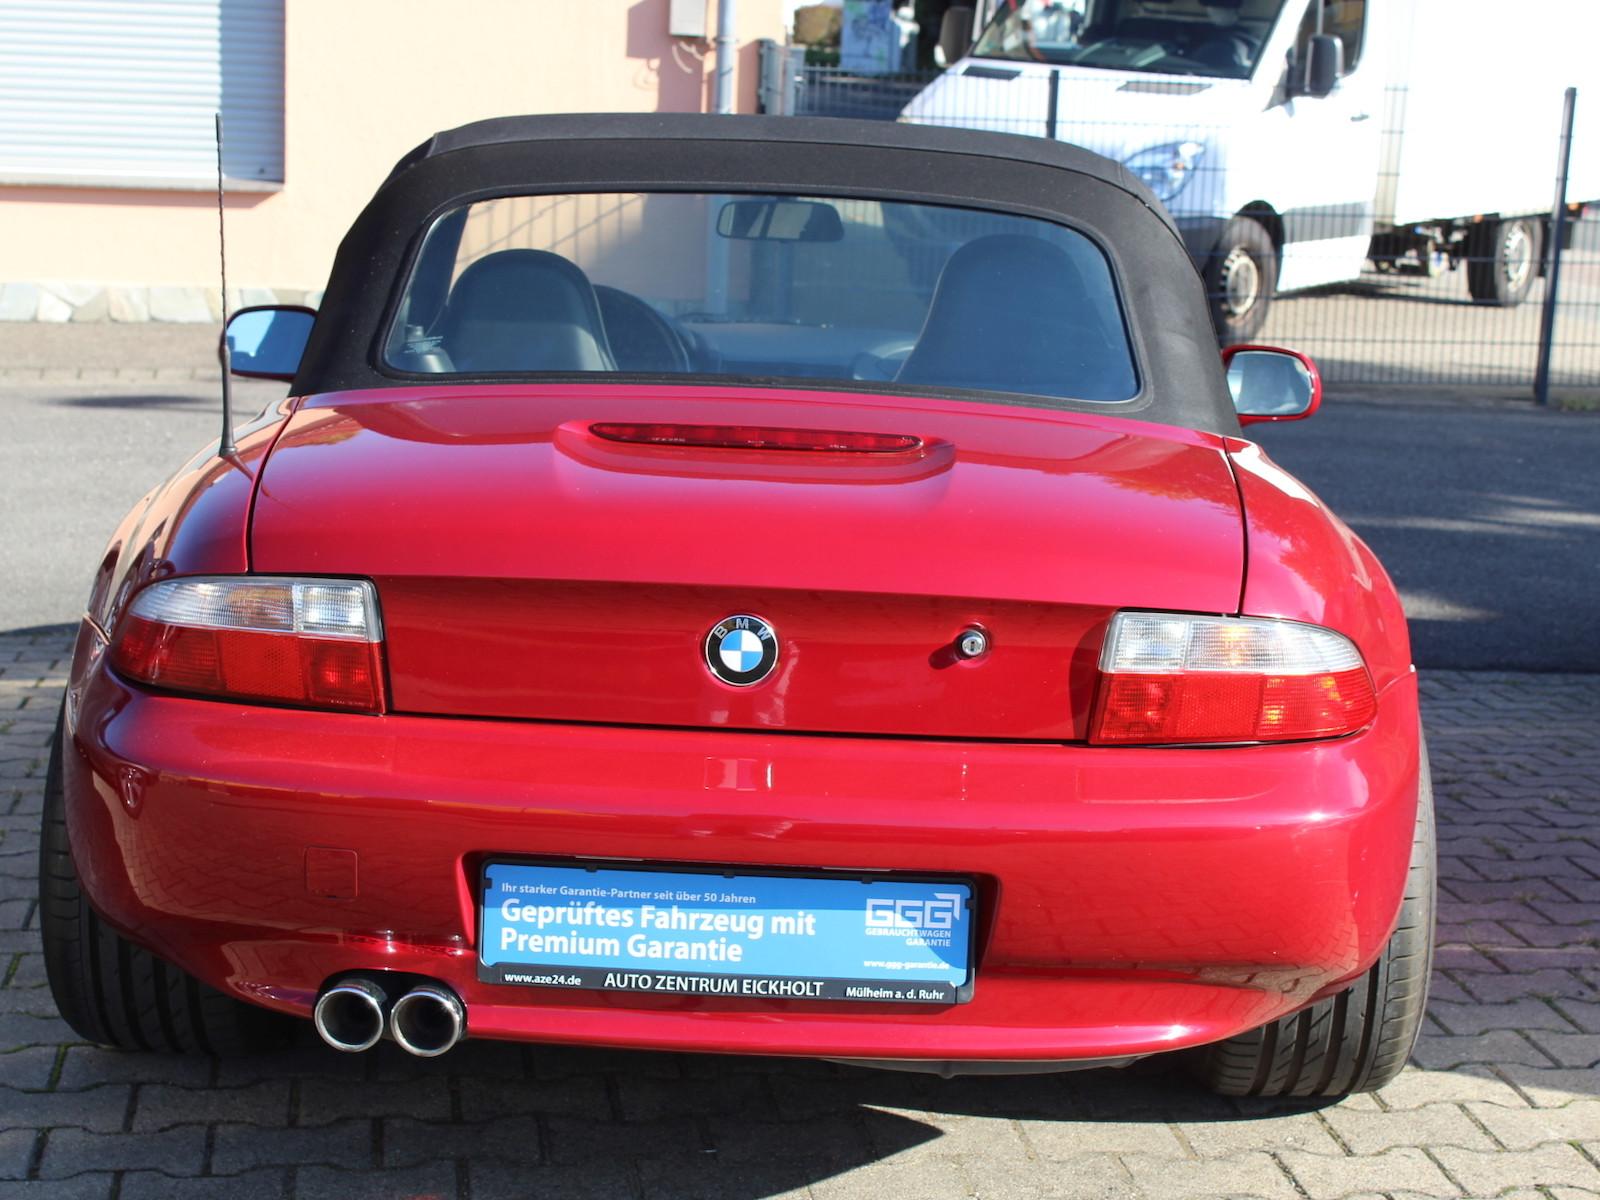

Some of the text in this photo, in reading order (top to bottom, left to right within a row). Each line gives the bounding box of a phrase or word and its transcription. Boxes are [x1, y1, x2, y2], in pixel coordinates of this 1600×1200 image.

[714, 618, 771, 641] BMW
[502, 883, 756, 904] Ihr starker Garantie-Partner seit über 50 Jahren
[501, 898, 817, 940] Geprüftes Fahrzeug mit
[865, 898, 953, 929] GGG
[501, 927, 743, 962] Premium Garantie
[864, 927, 952, 938] GEBRAUCHTWAGEN
[905, 937, 952, 947] GARANTIE
[504, 972, 945, 1000] www.aze24.de AUTO ZENTRUM EICKHOLT Mülheim a. d. Ruhr
